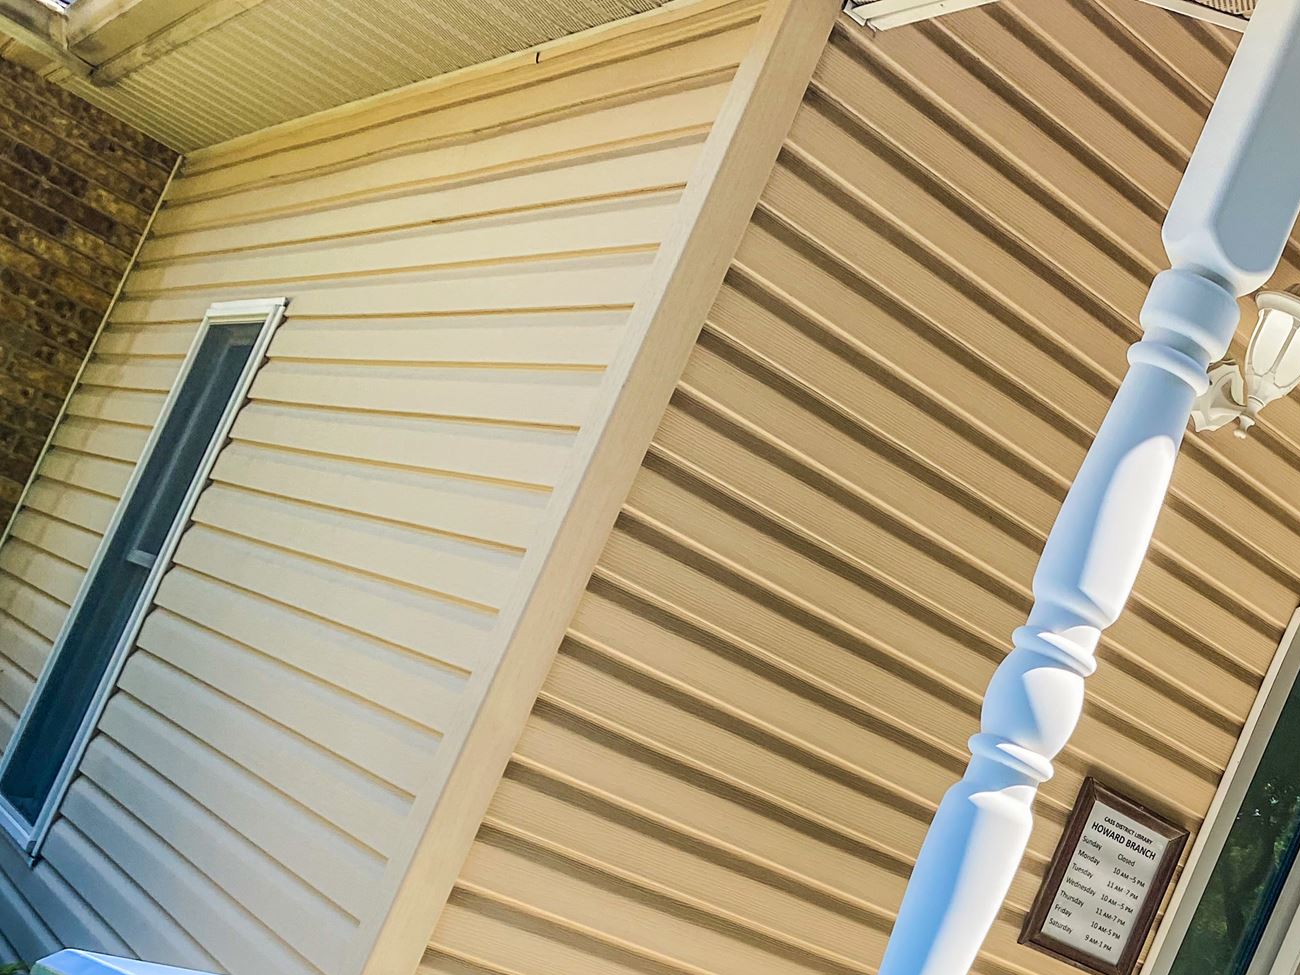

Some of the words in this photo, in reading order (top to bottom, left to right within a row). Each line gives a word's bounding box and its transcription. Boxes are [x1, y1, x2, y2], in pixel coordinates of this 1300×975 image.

[1092, 821, 1126, 844] HOWARD
[1126, 839, 1156, 860] BRANCH
[1104, 816, 1115, 826] CASS
[1115, 822, 1134, 835] DISTRICT
[1134, 832, 1152, 844] LIBRARY
[1082, 835, 1102, 850] Sunday
[1117, 853, 1136, 867] Closed
[1072, 862, 1094, 880] Tuesday
[1106, 880, 1114, 888] 11
[1130, 892, 1138, 900] PM
[1078, 849, 1100, 866] Monday
[1112, 867, 1120, 875] 10
[1136, 880, 1146, 888] PM
[1060, 890, 1084, 908] Thursday
[1096, 908, 1103, 916] 11
[1066, 876, 1096, 896] Wednesday
[1100, 894, 1108, 902] 10
[1124, 906, 1134, 914] PM
[1048, 918, 1073, 934] Saturday
[1054, 904, 1072, 918] Friday
[1090, 921, 1098, 929] 10
